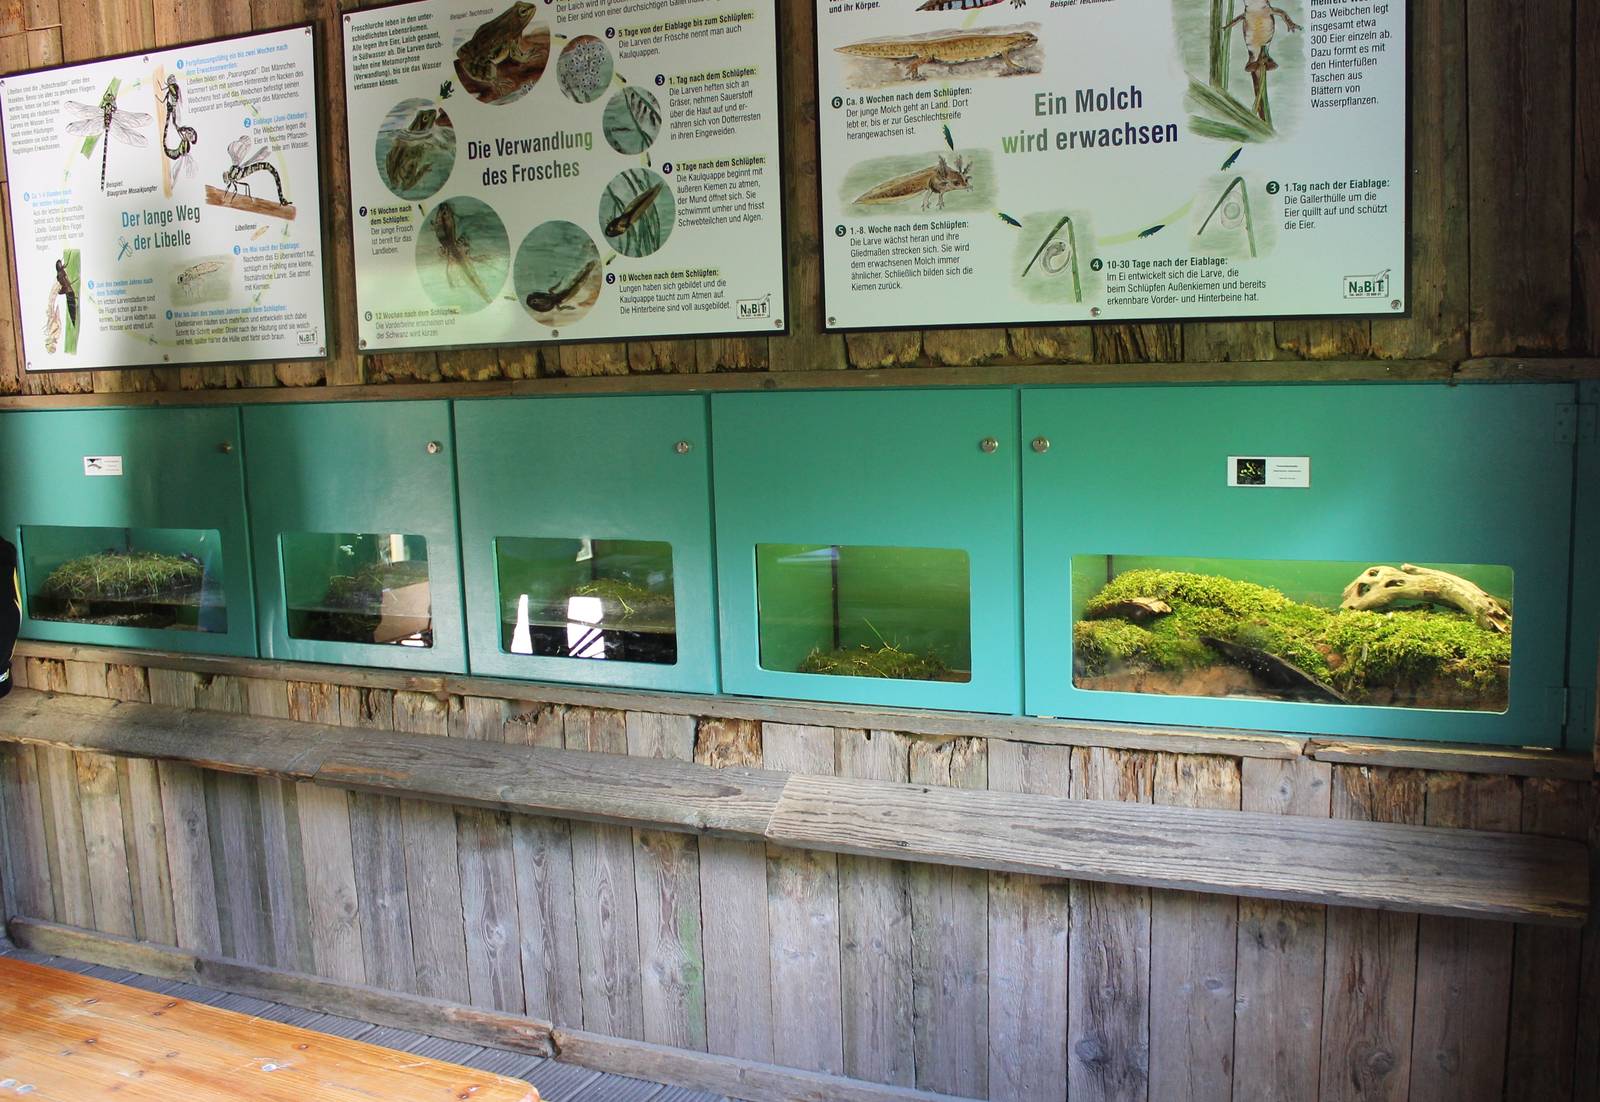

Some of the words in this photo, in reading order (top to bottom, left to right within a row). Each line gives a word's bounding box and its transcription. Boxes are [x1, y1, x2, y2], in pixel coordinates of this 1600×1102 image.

[829, 4, 842, 14] und
[844, 3, 853, 12] ihr
[856, 1, 881, 11] Körper.
[1311, 10, 1326, 19] Das
[1329, 6, 1370, 17] Weibchen
[1373, 4, 1389, 15] legt
[624, 29, 638, 37] Tage
[665, 22, 692, 31] Eiablage
[720, 13, 754, 23] Schlüpfen:
[1311, 20, 1354, 33] insgesamt
[1356, 19, 1376, 28] etwa
[630, 38, 652, 47] Larven
[664, 32, 689, 42] Frösche
[691, 30, 708, 38] nennt
[726, 25, 742, 34] auch
[1311, 34, 1327, 44] 300
[1330, 34, 1345, 43] Eier
[1348, 31, 1377, 41] einzeln
[1380, 30, 1393, 39] ab.
[1311, 48, 1331, 57] Dazu
[1334, 46, 1357, 55] formt
[1372, 44, 1386, 52] mit
[1311, 61, 1326, 70] den
[1329, 57, 1377, 68] Hinterfüßen
[1312, 73, 1345, 83] Taschen
[860, 96, 864, 105] 8
[866, 94, 894, 104] Wochen
[896, 92, 913, 101] nach
[916, 91, 931, 99] dem
[934, 87, 972, 98] Schlüpfen:
[1311, 86, 1342, 95] Blättern
[1035, 93, 1066, 116] Ein
[1076, 86, 1142, 112] Molch
[1311, 97, 1379, 108] Wasserpflanzen.
[846, 109, 858, 118] Der
[860, 109, 878, 118] junge
[880, 104, 901, 114] Molch
[903, 103, 918, 114] geht
[953, 99, 968, 108] Dort
[847, 120, 859, 129] lebt
[871, 118, 881, 127] bis
[904, 111, 961, 124] Geschlechtsreife
[847, 128, 904, 141] herangewachsen
[1003, 130, 1048, 153] wird
[1056, 124, 1178, 150] erwachsen
[468, 140, 491, 160] Die
[496, 130, 592, 157] Verwandlung
[682, 164, 697, 172] Tage
[699, 161, 714, 169] nach
[732, 157, 766, 166] Schlüpfen:
[483, 167, 507, 186] des
[512, 159, 579, 183] Frosches
[689, 173, 725, 182] Kaulquappe
[727, 169, 751, 179] beginnt
[1310, 181, 1330, 191] nach
[1333, 181, 1347, 190] der
[1350, 179, 1390, 190] Eiablage:
[689, 195, 707, 204] Mund
[1285, 195, 1298, 204] Die
[1300, 193, 1346, 204] Gallerthülle
[1364, 192, 1376, 201] die
[122, 211, 140, 227] Der
[144, 210, 173, 227] lange
[176, 205, 200, 223] Weg
[678, 207, 711, 216] schwimmt
[712, 205, 733, 213] umher
[1285, 208, 1300, 217] Eier
[1302, 207, 1322, 218] quillt
[1324, 206, 1337, 215] auf
[1339, 205, 1355, 215] und
[1358, 204, 1388, 214] schützt
[678, 217, 727, 227] Schwebteilchen
[1284, 221, 1296, 230] die
[134, 234, 151, 250] der
[155, 230, 190, 248] Libelle
[1107, 260, 1130, 269] 10-30
[1132, 259, 1150, 270] Tage
[1153, 258, 1172, 267] nach
[1175, 258, 1188, 266] der
[1191, 257, 1228, 267] Eiablage:
[1107, 273, 1116, 281] Im
[1119, 272, 1126, 280] Ei
[1128, 271, 1166, 280] entwickelt
[1168, 270, 1184, 279] sich
[1187, 270, 1198, 278] die
[1201, 269, 1225, 278] Larve,
[1227, 269, 1239, 277] die
[1107, 285, 1126, 293] beim
[1128, 283, 1166, 294] Schlüpfen
[1168, 282, 1220, 291] Außenkiemen
[1223, 281, 1237, 290] und
[1240, 280, 1266, 289] bereits
[1348, 280, 1384, 292] NaBiT
[1107, 296, 1149, 305] erkennbare
[1151, 295, 1179, 304] Vorder-
[1181, 294, 1196, 303] und
[1198, 293, 1242, 302] Hinterbeine
[1244, 293, 1259, 301] hat.
